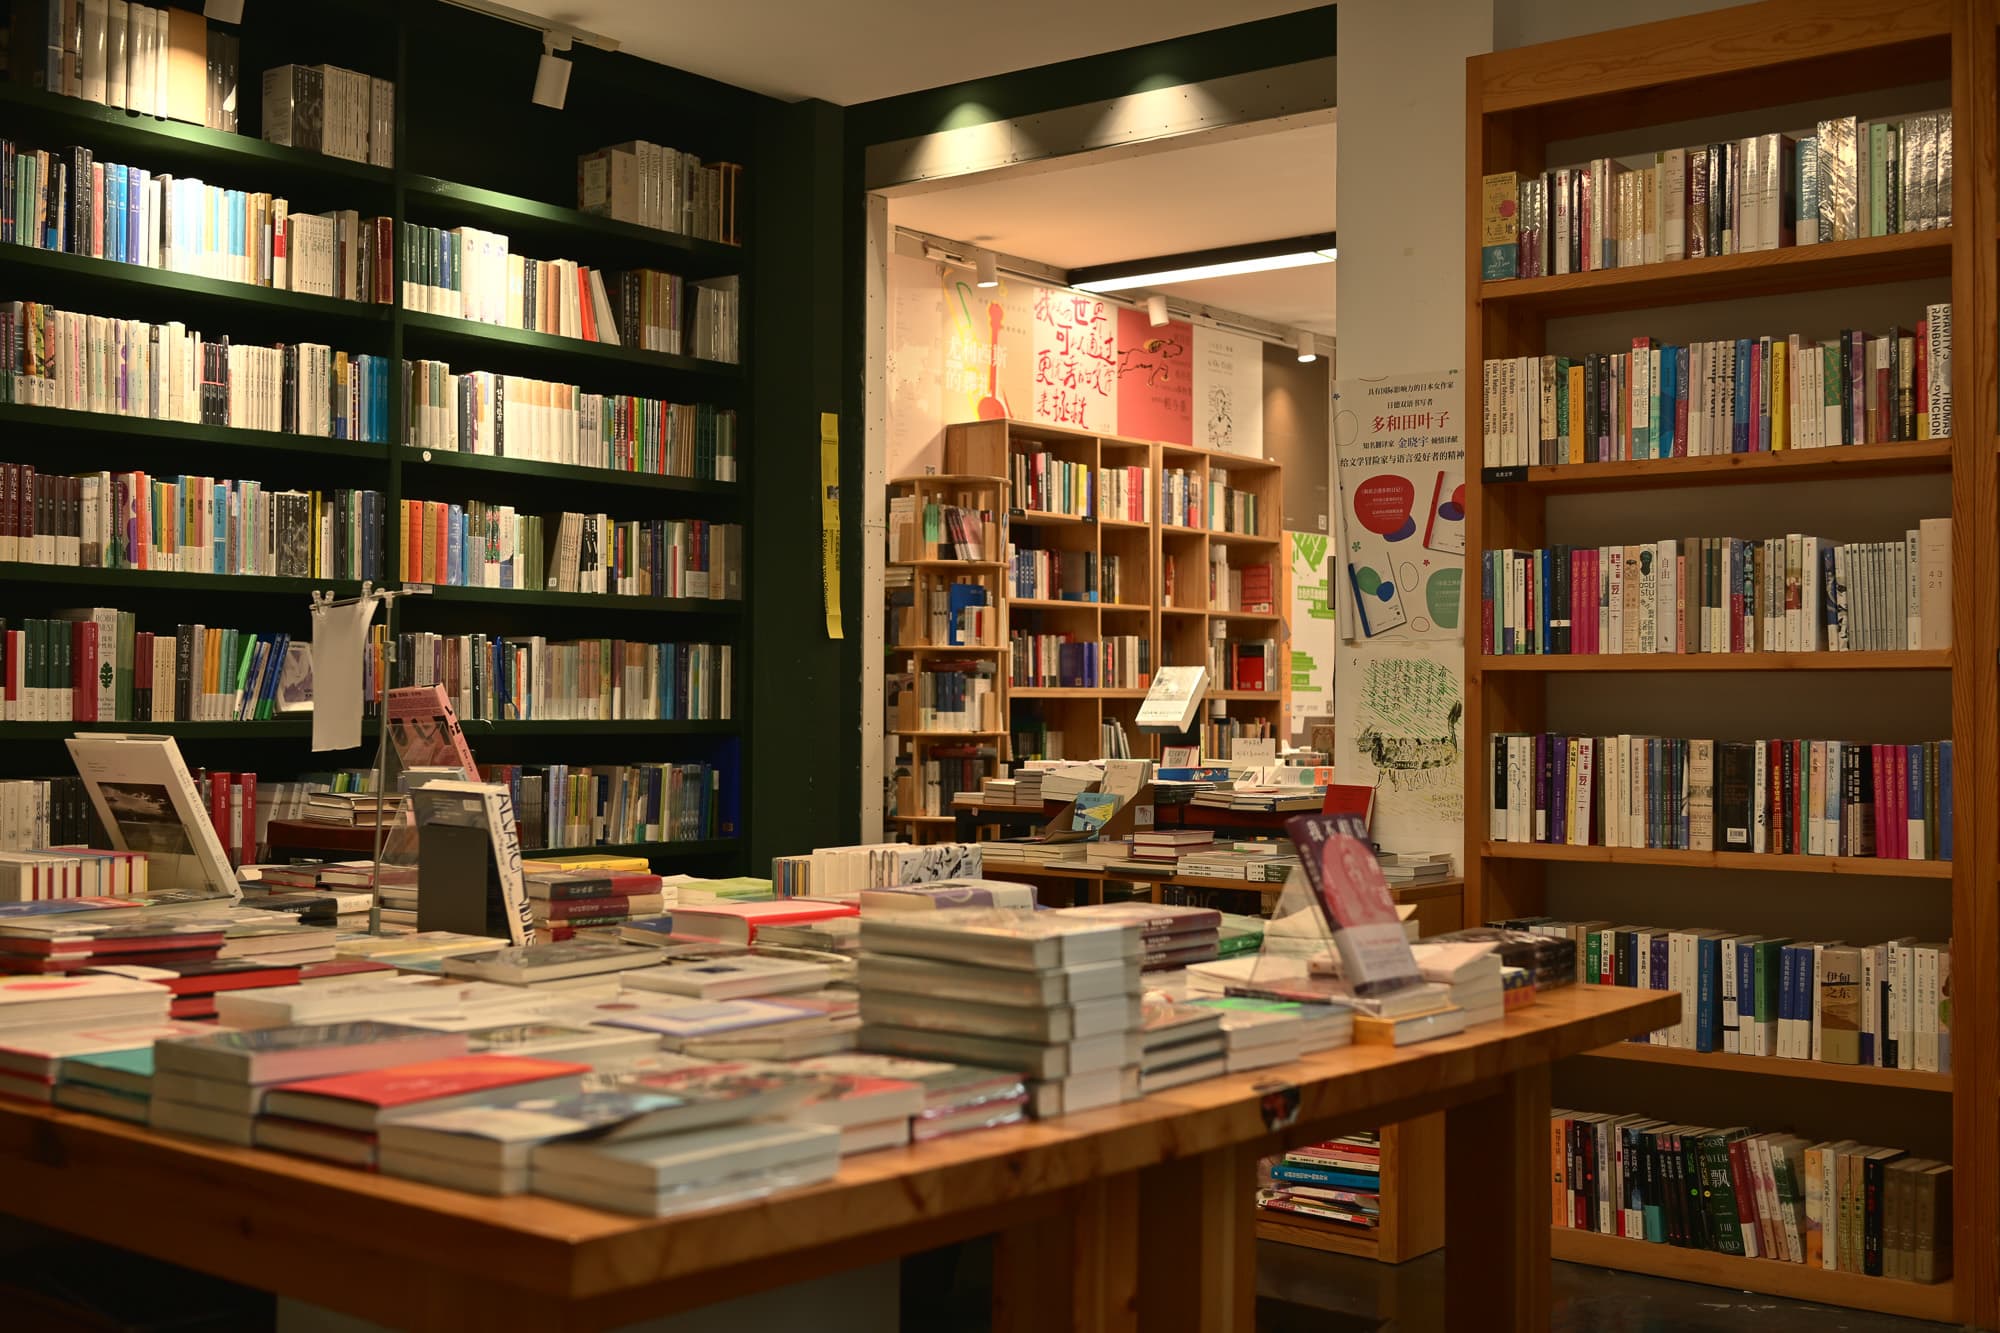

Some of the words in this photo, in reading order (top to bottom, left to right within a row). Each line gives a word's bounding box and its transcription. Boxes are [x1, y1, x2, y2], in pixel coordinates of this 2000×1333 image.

[1931, 307, 1942, 357] RAINBOW
[1931, 385, 1942, 436] PYNCHON
[1942, 392, 1952, 436] THOMAS
[1371, 411, 1450, 433] 多和田叶子
[1398, 435, 1428, 449] 金晓宇
[1661, 558, 1670, 580] 自由
[1928, 570, 1934, 578] 4
[1937, 570, 1943, 578] 3
[1827, 971, 1850, 983] 伊甸
[1826, 987, 1850, 999] 之东
[1710, 1169, 1730, 1188] 飘
